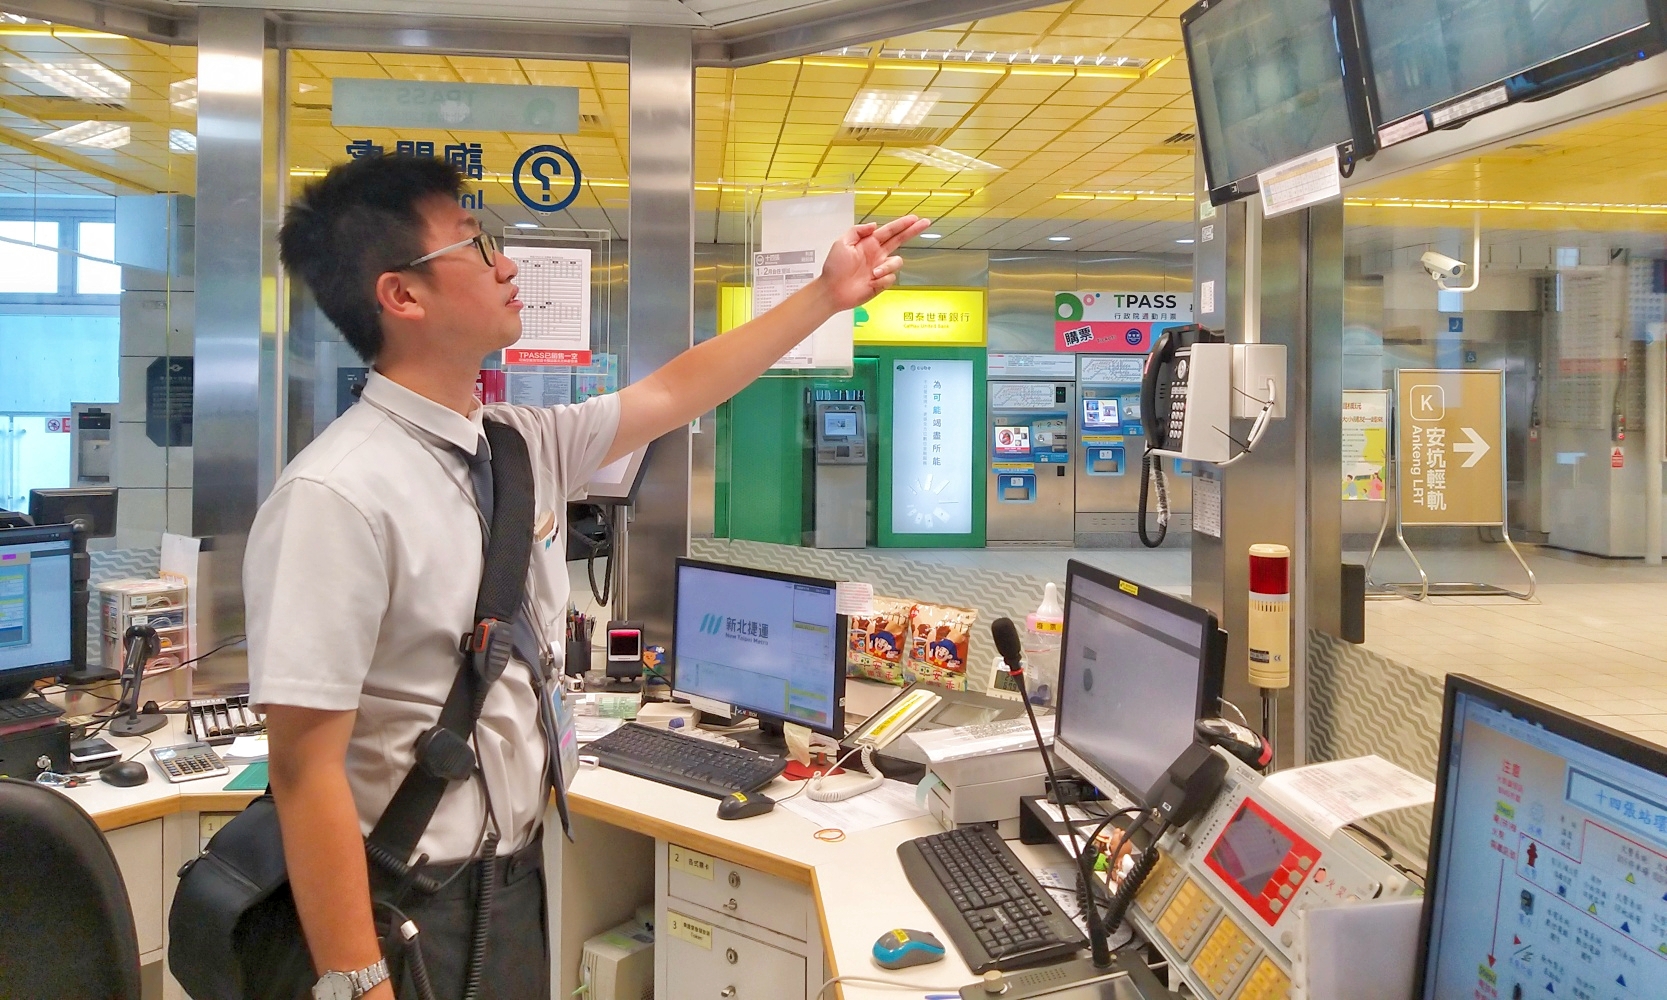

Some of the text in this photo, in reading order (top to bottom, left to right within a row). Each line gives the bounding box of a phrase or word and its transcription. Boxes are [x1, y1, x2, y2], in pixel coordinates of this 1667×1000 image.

[1113, 294, 1177, 308] TPASS
[903, 311, 970, 322] 國泰世華銀行
[1114, 312, 1177, 321] 行政院通勤月票
[1064, 327, 1093, 346] 購票
[1421, 394, 1434, 411] K
[932, 380, 942, 466] 為可能竭盡所能
[1411, 425, 1424, 506] Ankeng LRT
[1426, 427, 1447, 511] 安坑輕軌
[726, 617, 769, 638] 新北捷運
[737, 634, 752, 642] Taipei
[674, 853, 680, 863] 2
[673, 920, 678, 930] 3
